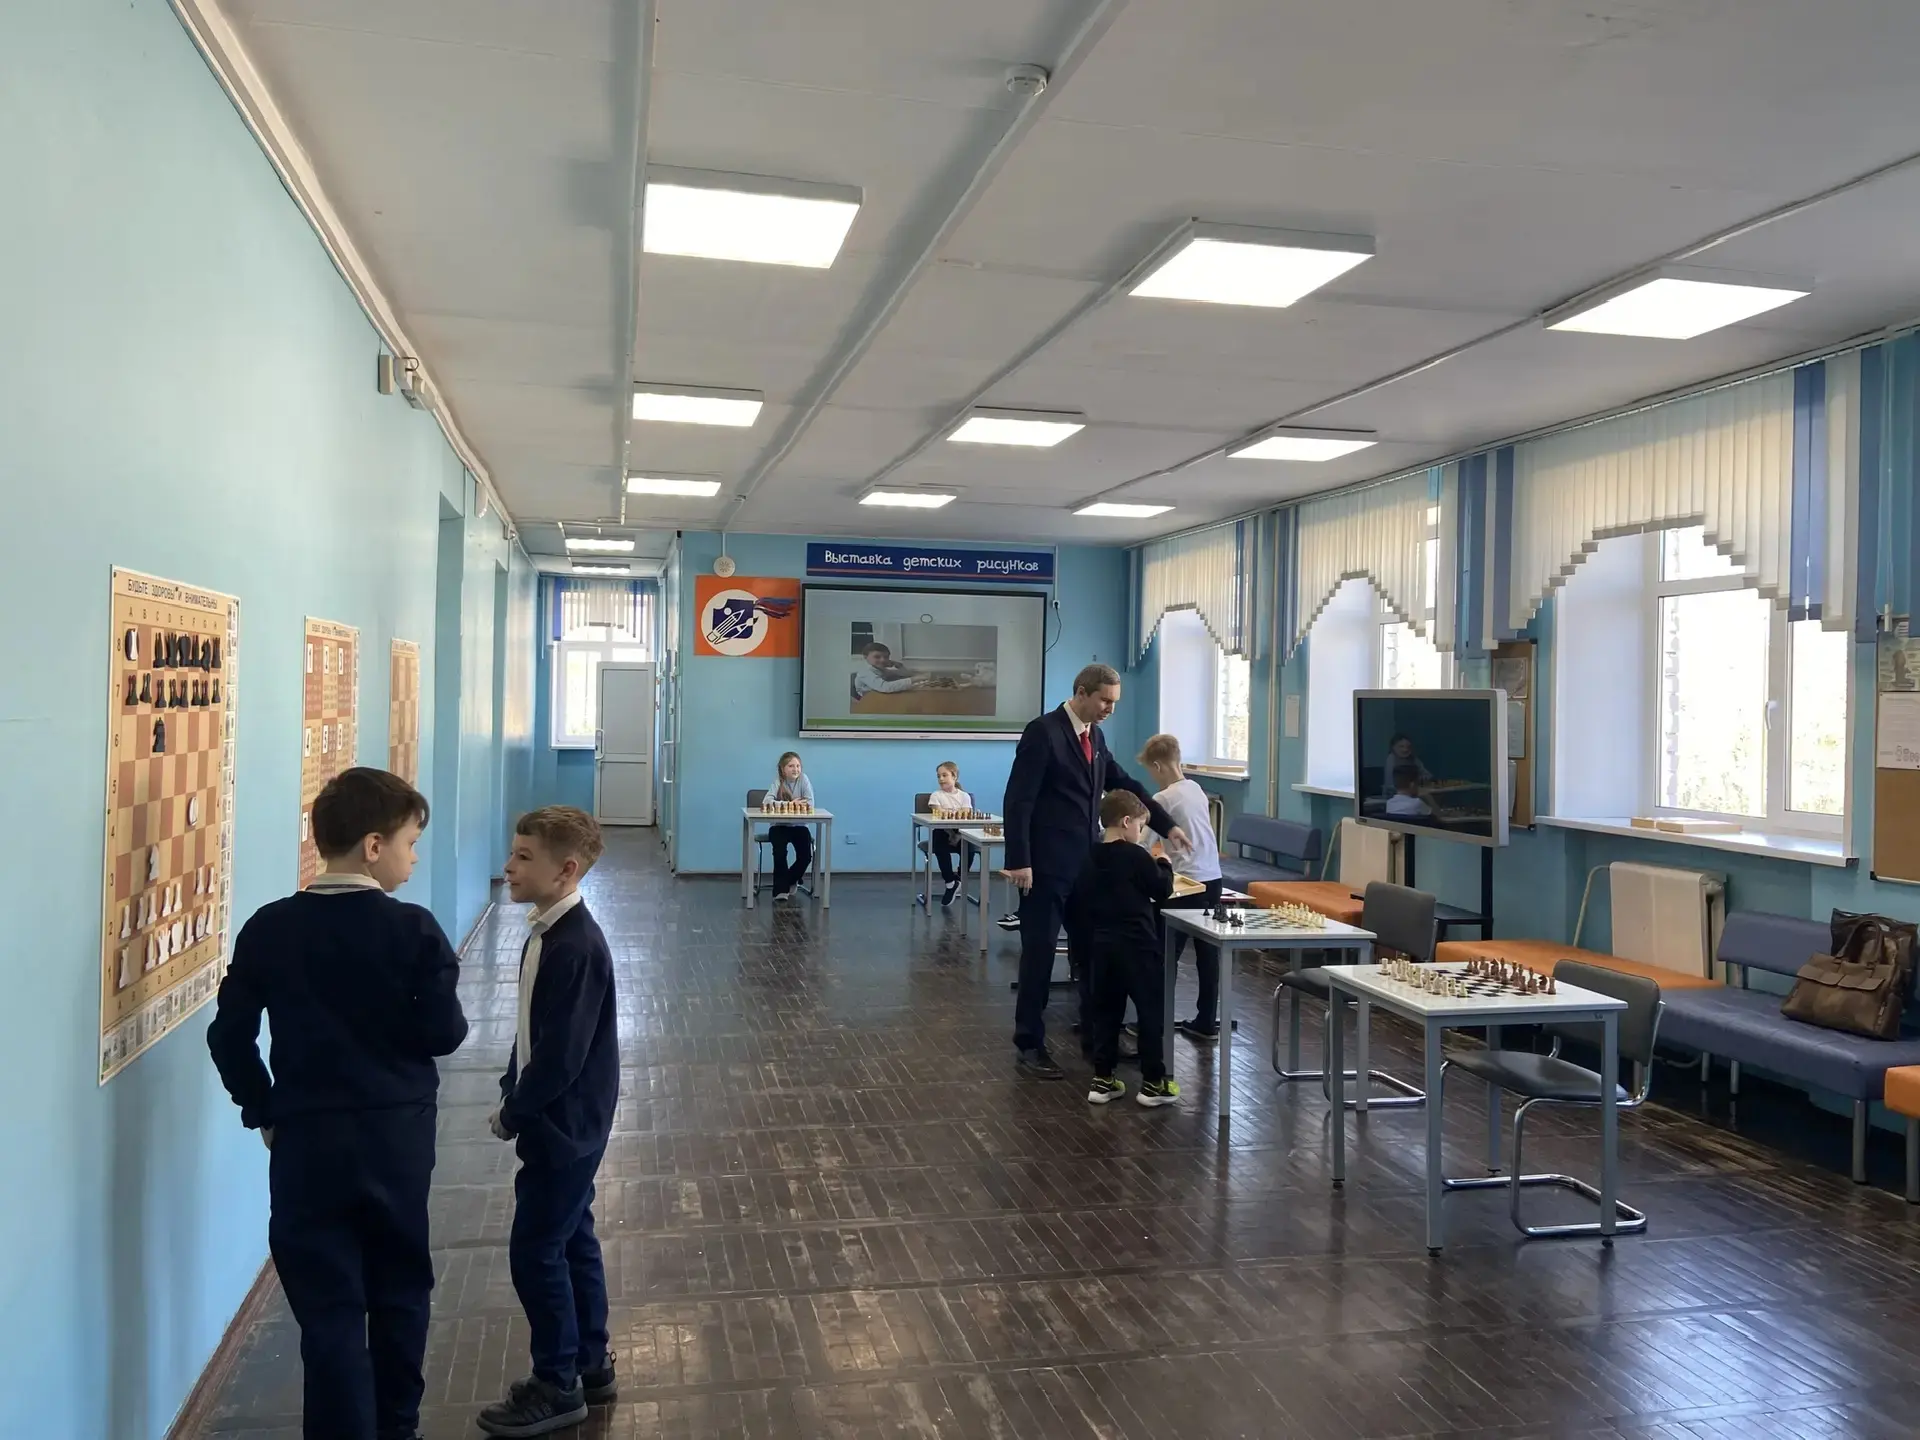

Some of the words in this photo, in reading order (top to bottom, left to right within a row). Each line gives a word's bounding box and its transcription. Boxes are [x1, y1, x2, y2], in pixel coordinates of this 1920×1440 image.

[824, 549, 893, 566] Выставка
[903, 555, 962, 571] детских
[976, 559, 1039, 575] рисунков
[127, 578, 149, 595] БУДЬТЕ
[151, 584, 175, 600] ЗДОРОВЫ
[185, 592, 218, 610] ВНИМАТЕЛЬНЫ
